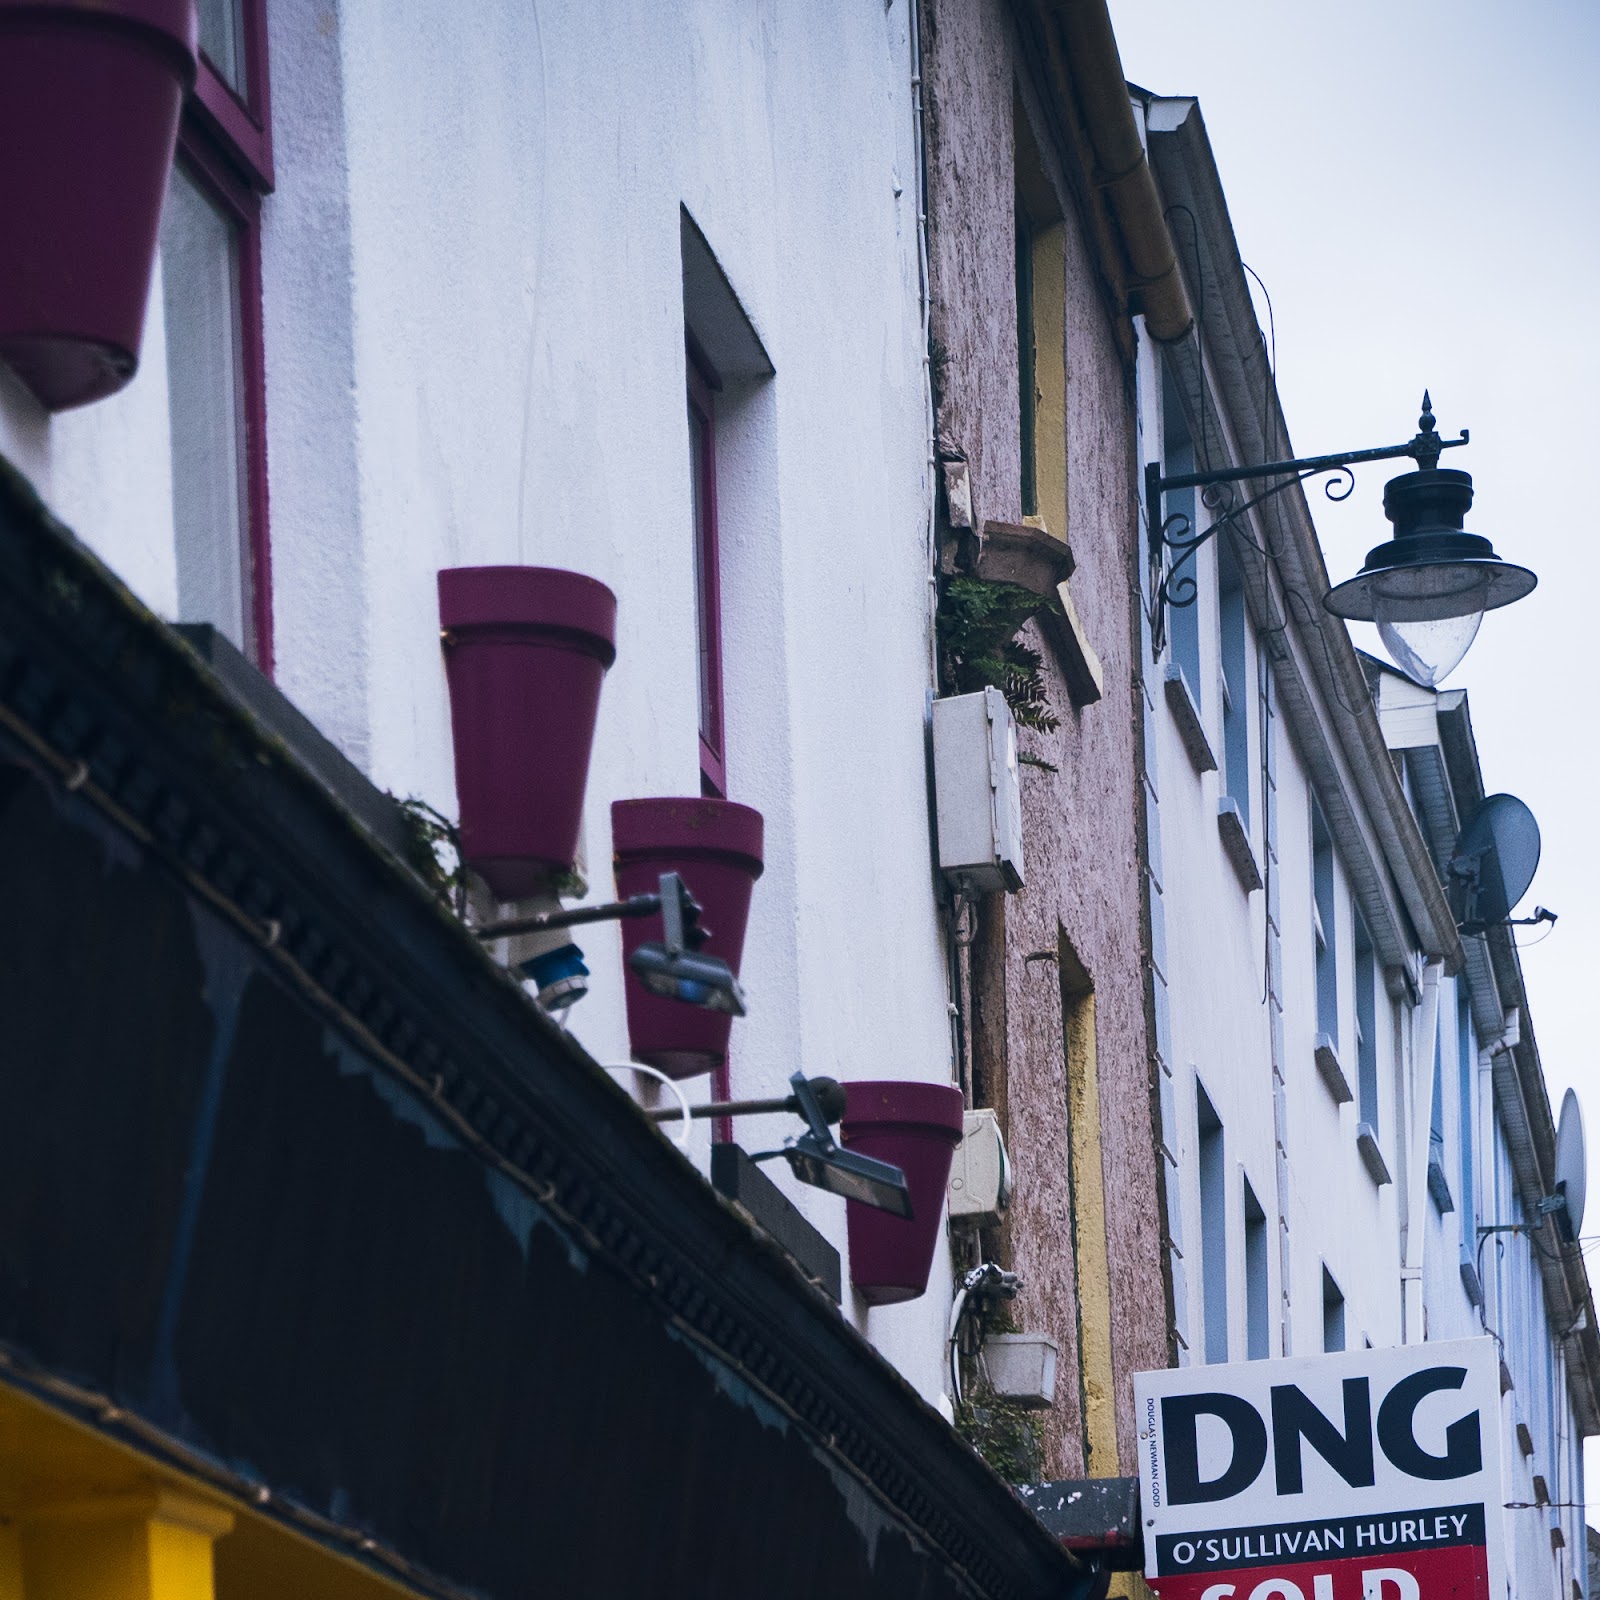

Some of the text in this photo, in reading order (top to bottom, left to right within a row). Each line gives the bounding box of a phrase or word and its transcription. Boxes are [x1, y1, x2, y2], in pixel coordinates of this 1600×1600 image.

[1146, 1397, 1161, 1508] DOUGLAS NEWMAN GOOD
[1161, 1366, 1483, 1506] DNG
[1172, 1513, 1468, 1565] O'SULLIVAN HURLEY
